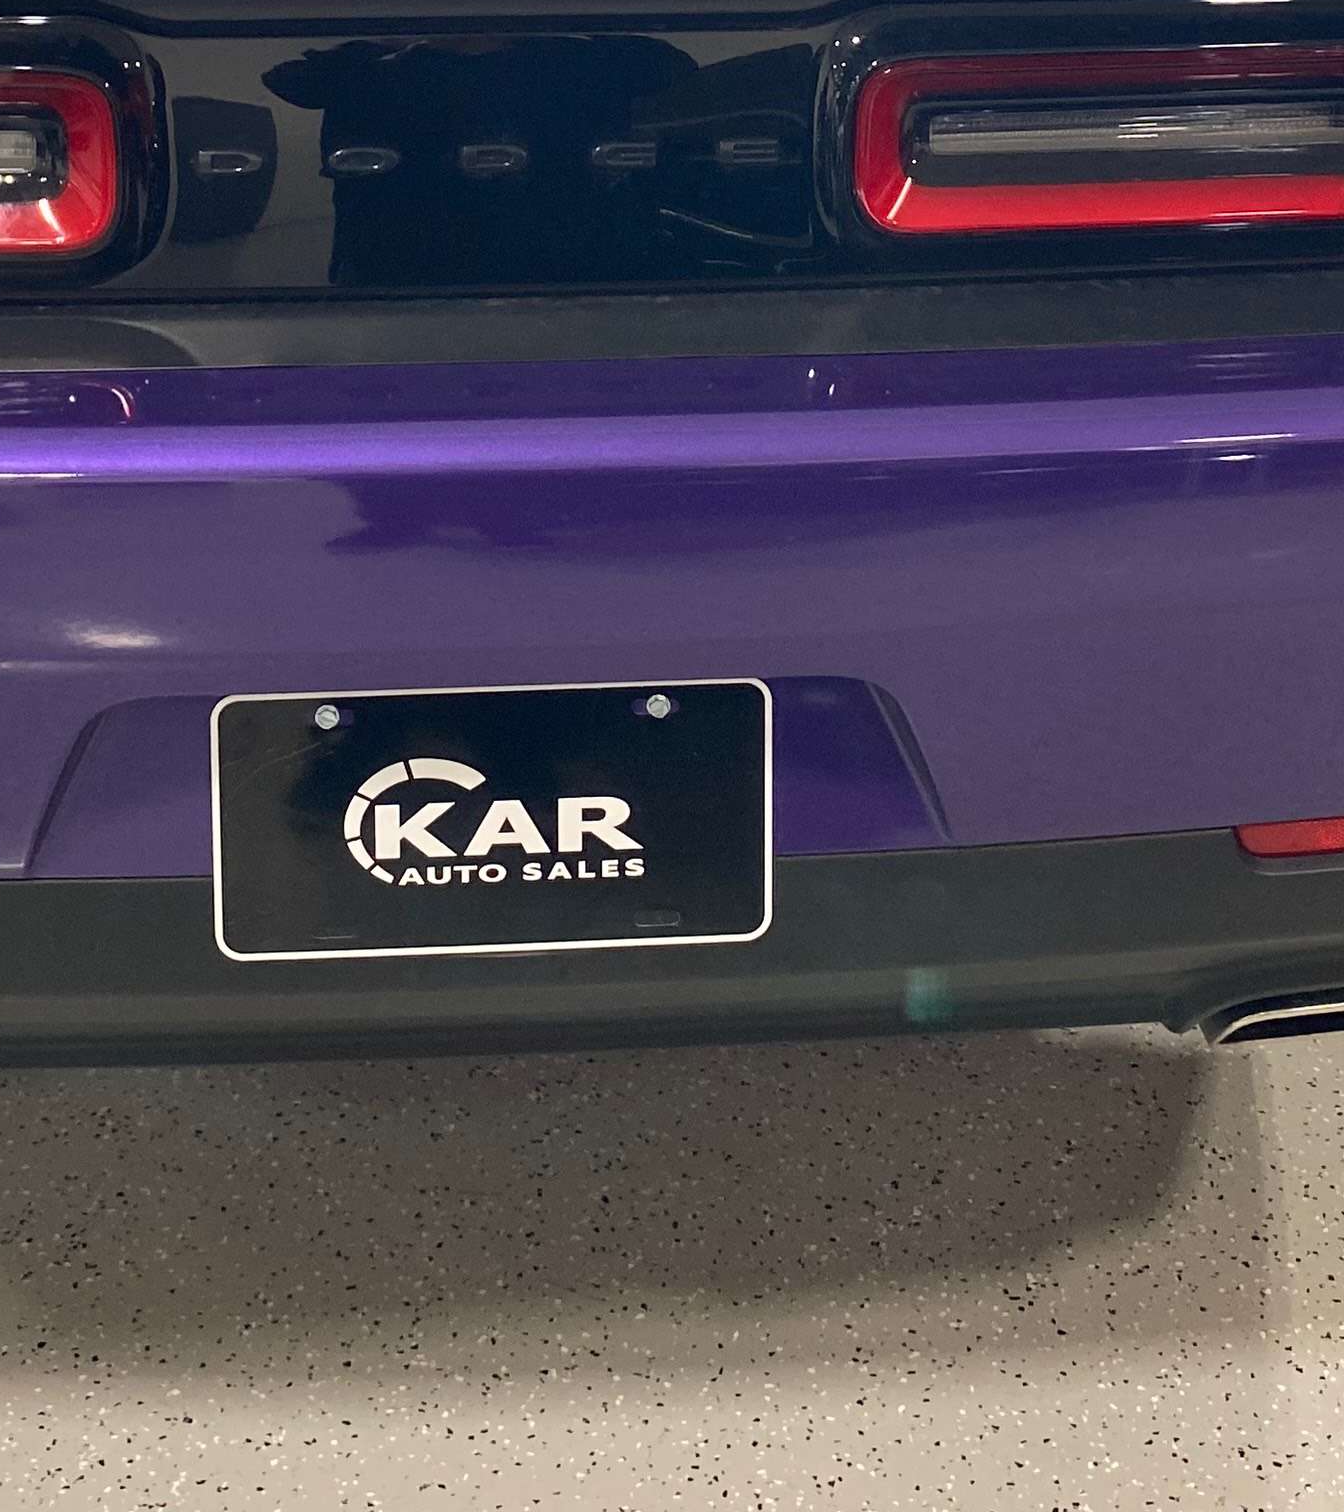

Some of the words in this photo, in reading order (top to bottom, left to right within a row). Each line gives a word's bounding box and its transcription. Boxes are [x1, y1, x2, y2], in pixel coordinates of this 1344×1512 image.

[197, 138, 779, 174] DODGE
[373, 795, 645, 860] KAR
[398, 862, 508, 887] AUTO
[521, 856, 646, 882] SALES
